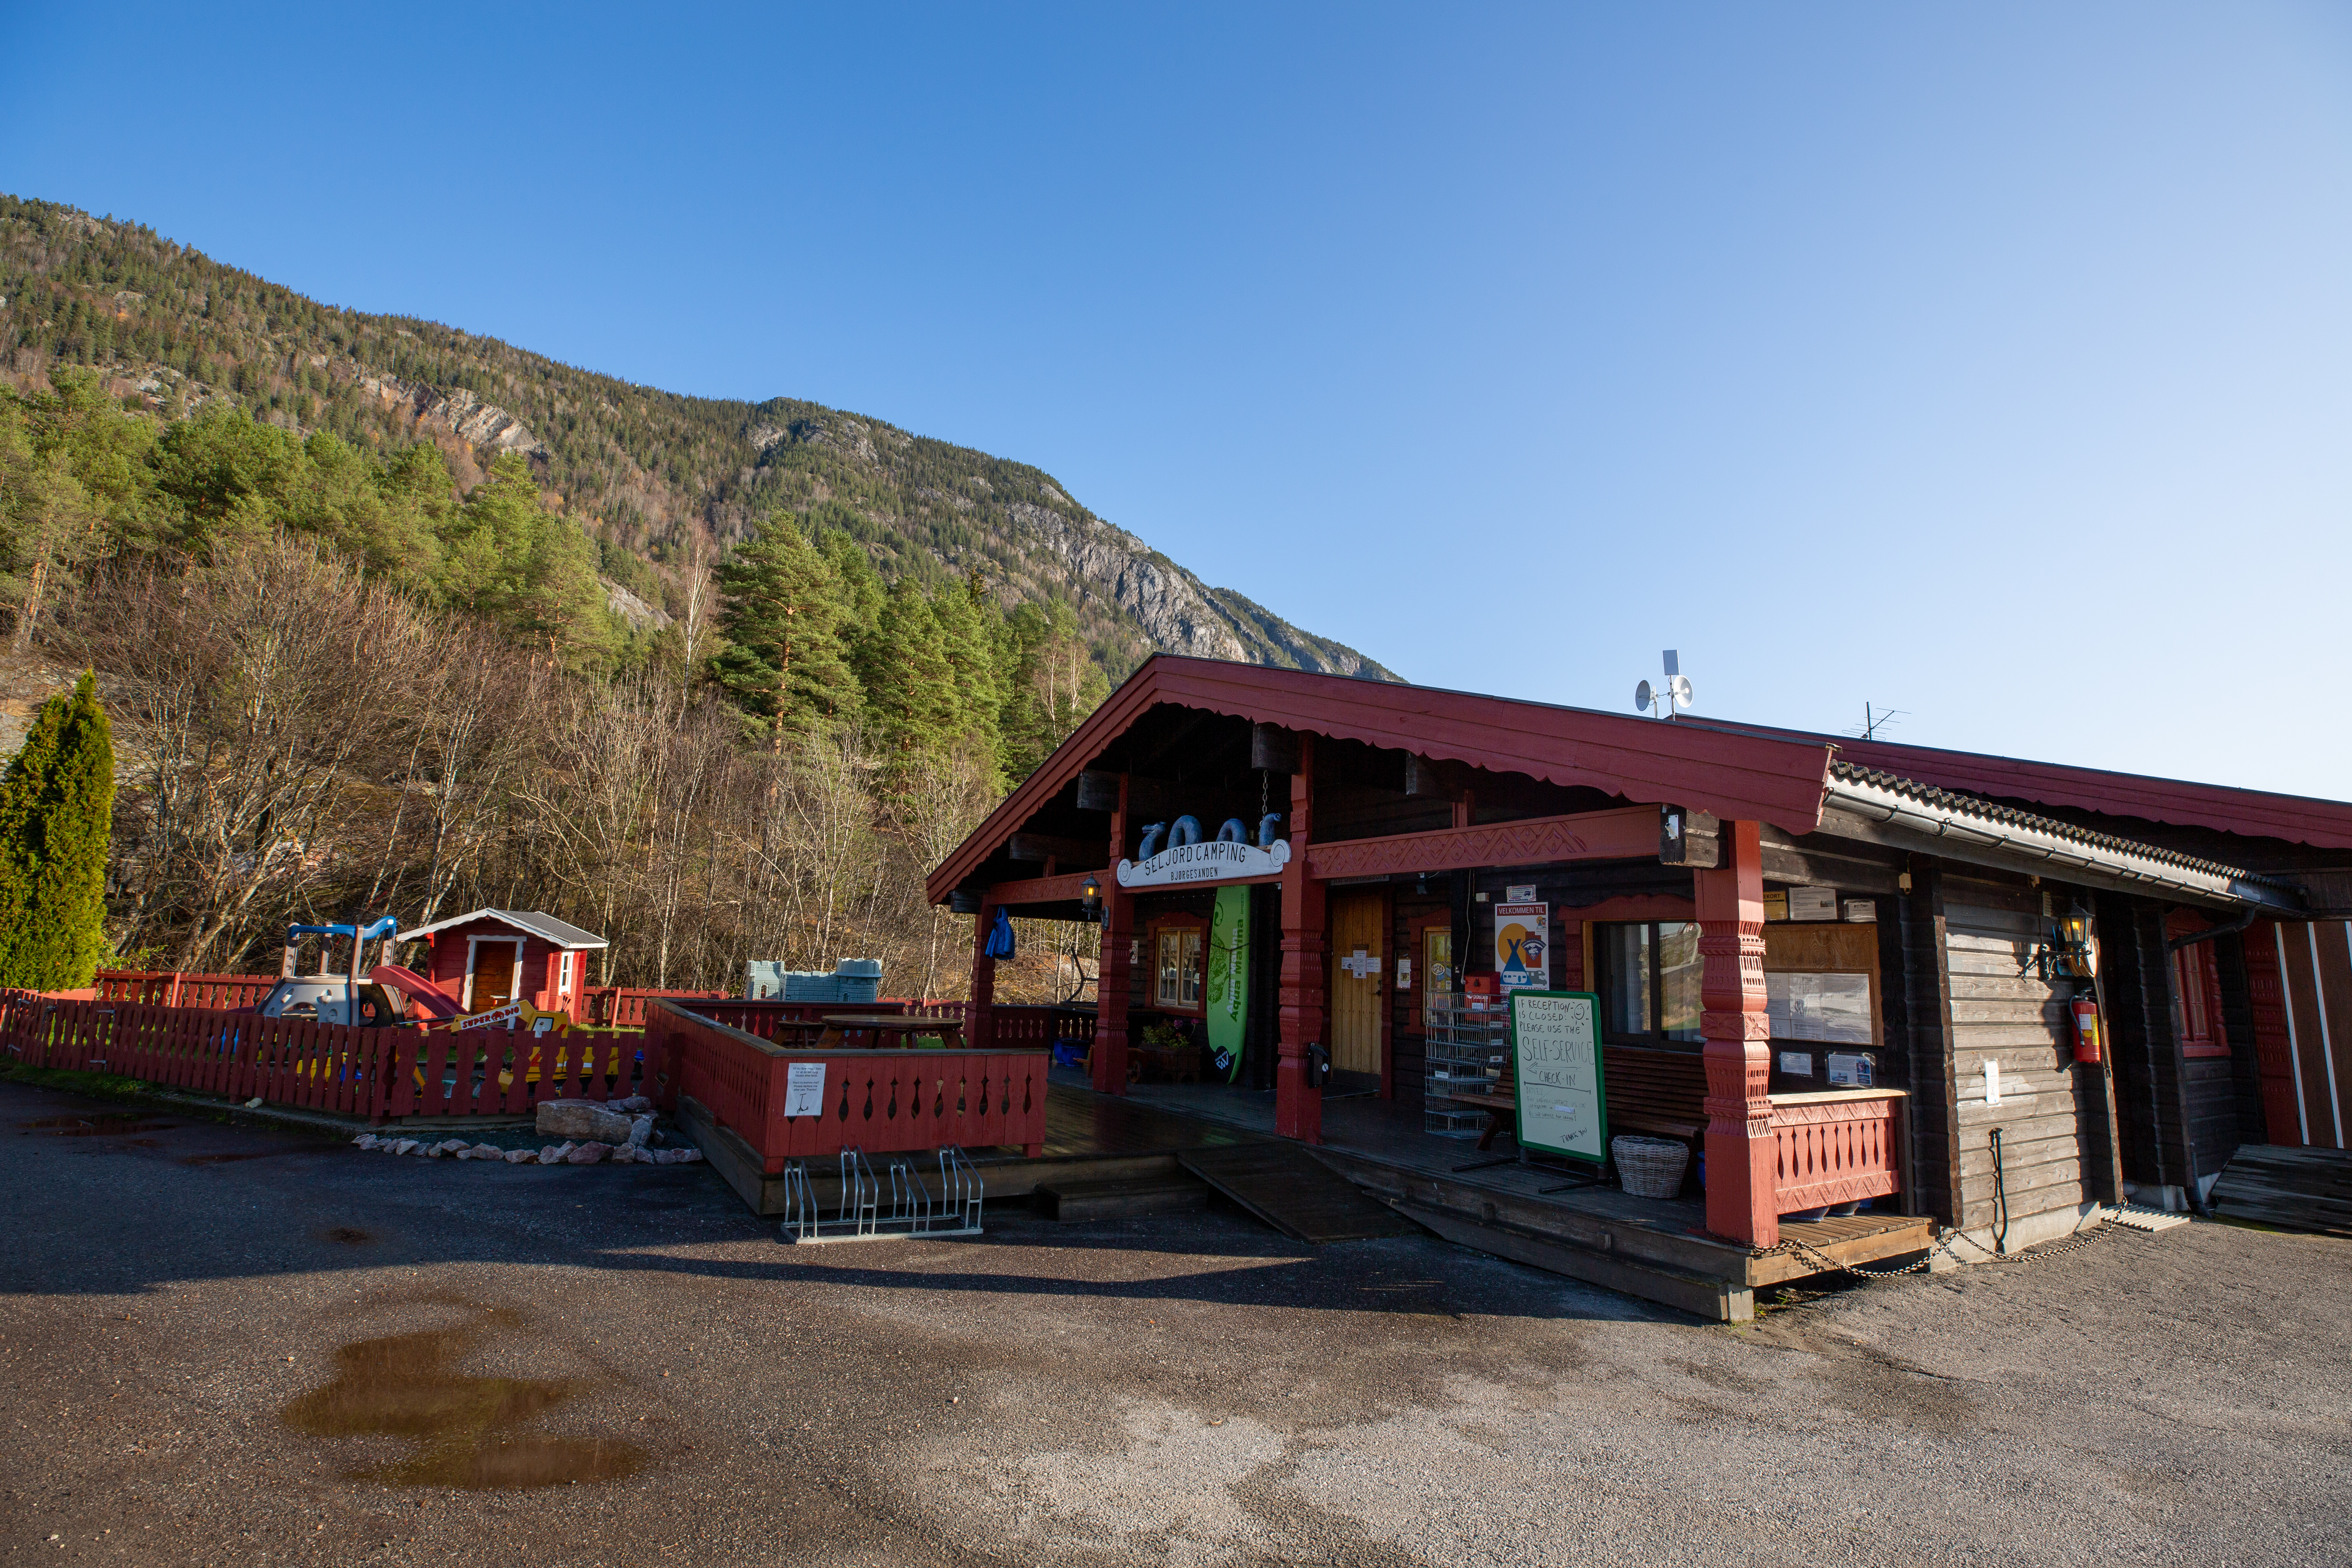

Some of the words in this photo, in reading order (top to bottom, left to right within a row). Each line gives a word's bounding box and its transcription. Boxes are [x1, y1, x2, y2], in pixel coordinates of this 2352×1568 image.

[1196, 843, 1245, 862] CAMPING
[1171, 867, 1218, 880] BJØRGESANDEN
[1227, 979, 1235, 1014] Aqua
[1230, 980, 1241, 1022] Aqua
[1518, 1000, 1524, 1008] IF
[1528, 1000, 1570, 1013] RECEPTION
[463, 1015, 491, 1028] SUPER
[505, 1006, 519, 1016] DIG
[1519, 1010, 1525, 1018] IS
[1529, 1011, 1567, 1021] CLOSED:
[1519, 1021, 1544, 1033] PLEASE
[1565, 1026, 1580, 1034] THE
[1522, 1036, 1594, 1065] SELF-SERVICE
[1539, 1071, 1575, 1086] CHECK-IN
[1559, 1131, 1578, 1143] THANK
[1578, 1127, 1587, 1137] YOU
